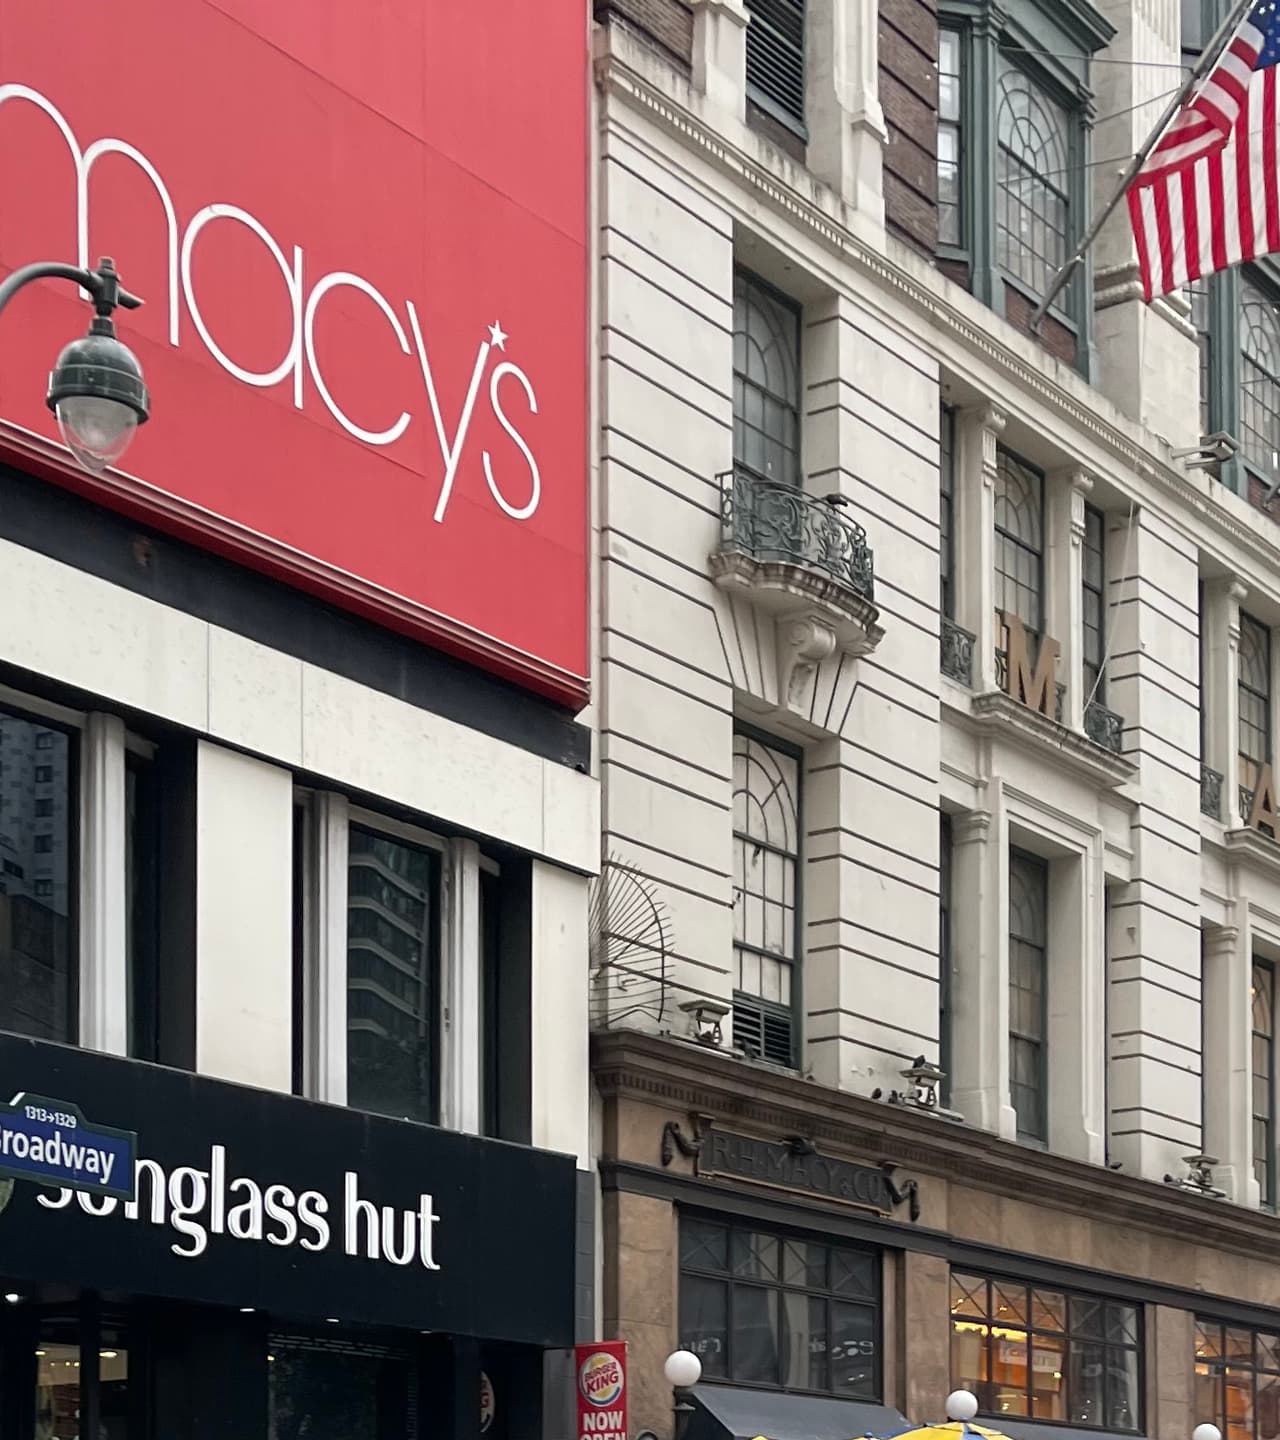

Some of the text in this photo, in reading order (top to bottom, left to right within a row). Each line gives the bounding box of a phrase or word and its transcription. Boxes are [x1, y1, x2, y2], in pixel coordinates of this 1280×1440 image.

[344, 1171, 441, 1271] hut
[584, 1361, 618, 1382] BURGER
[585, 1370, 620, 1395] KING
[583, 1410, 624, 1432] NOW
